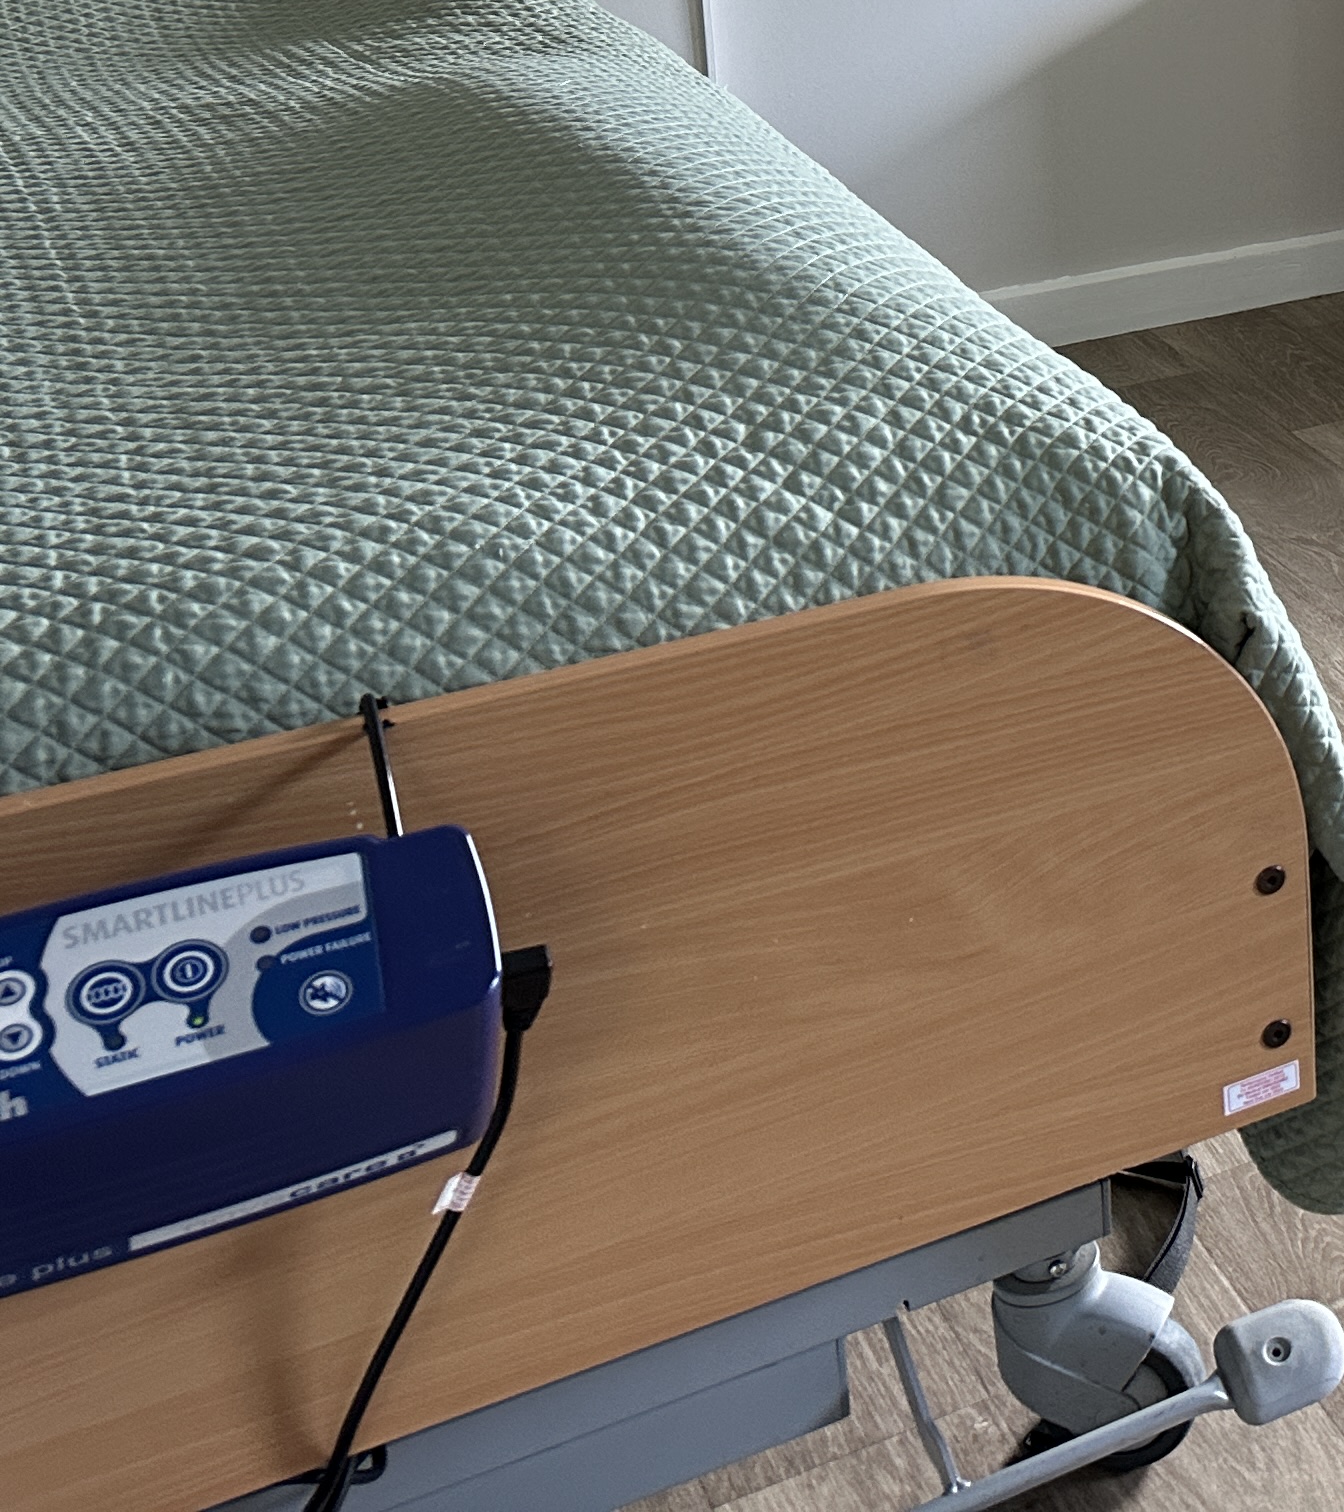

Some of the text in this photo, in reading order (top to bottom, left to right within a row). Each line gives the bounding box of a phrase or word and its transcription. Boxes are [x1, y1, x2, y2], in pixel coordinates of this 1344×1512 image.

[62, 870, 305, 949] SMARTLINEPLUS
[275, 904, 361, 935] LOW PRESSURE
[280, 931, 372, 965] POWER FAILURE
[175, 1024, 226, 1047] POWER
[94, 1047, 140, 1069] STATIC
[31, 1246, 112, 1282] plus
